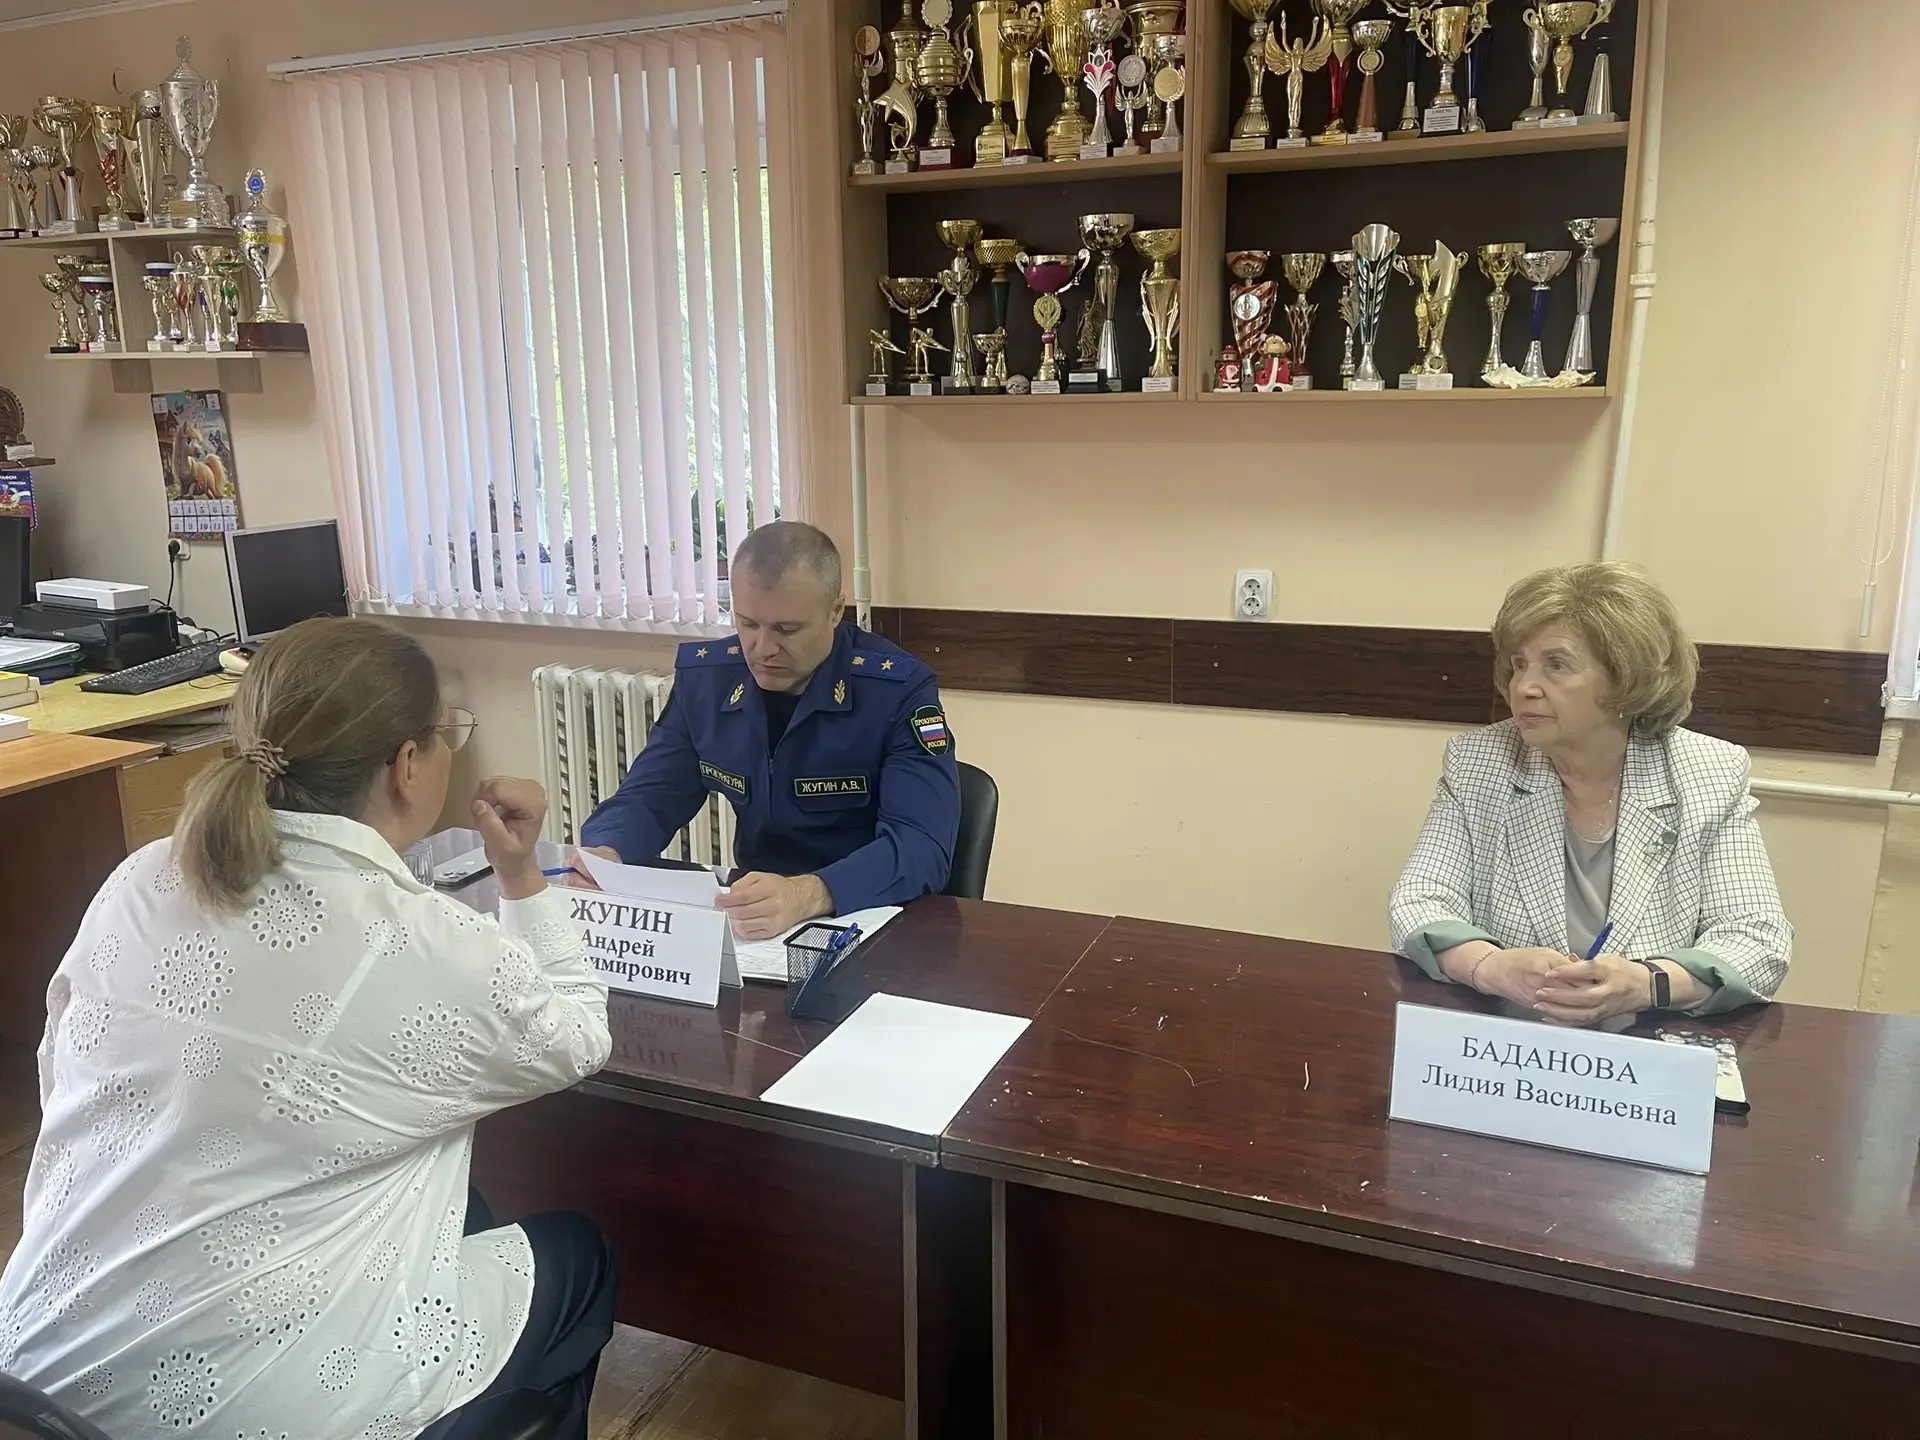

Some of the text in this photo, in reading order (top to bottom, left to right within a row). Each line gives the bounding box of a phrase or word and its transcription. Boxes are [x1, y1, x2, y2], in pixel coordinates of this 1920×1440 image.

[801, 780, 861, 793] ЖУГИН А.В.
[570, 897, 674, 935] ЖУГИН
[581, 928, 656, 960] Андрей
[590, 955, 692, 986] имирович
[1460, 1036, 1640, 1085] БАДАНОВА
[1422, 1063, 1678, 1126] Лидия Васильевна
